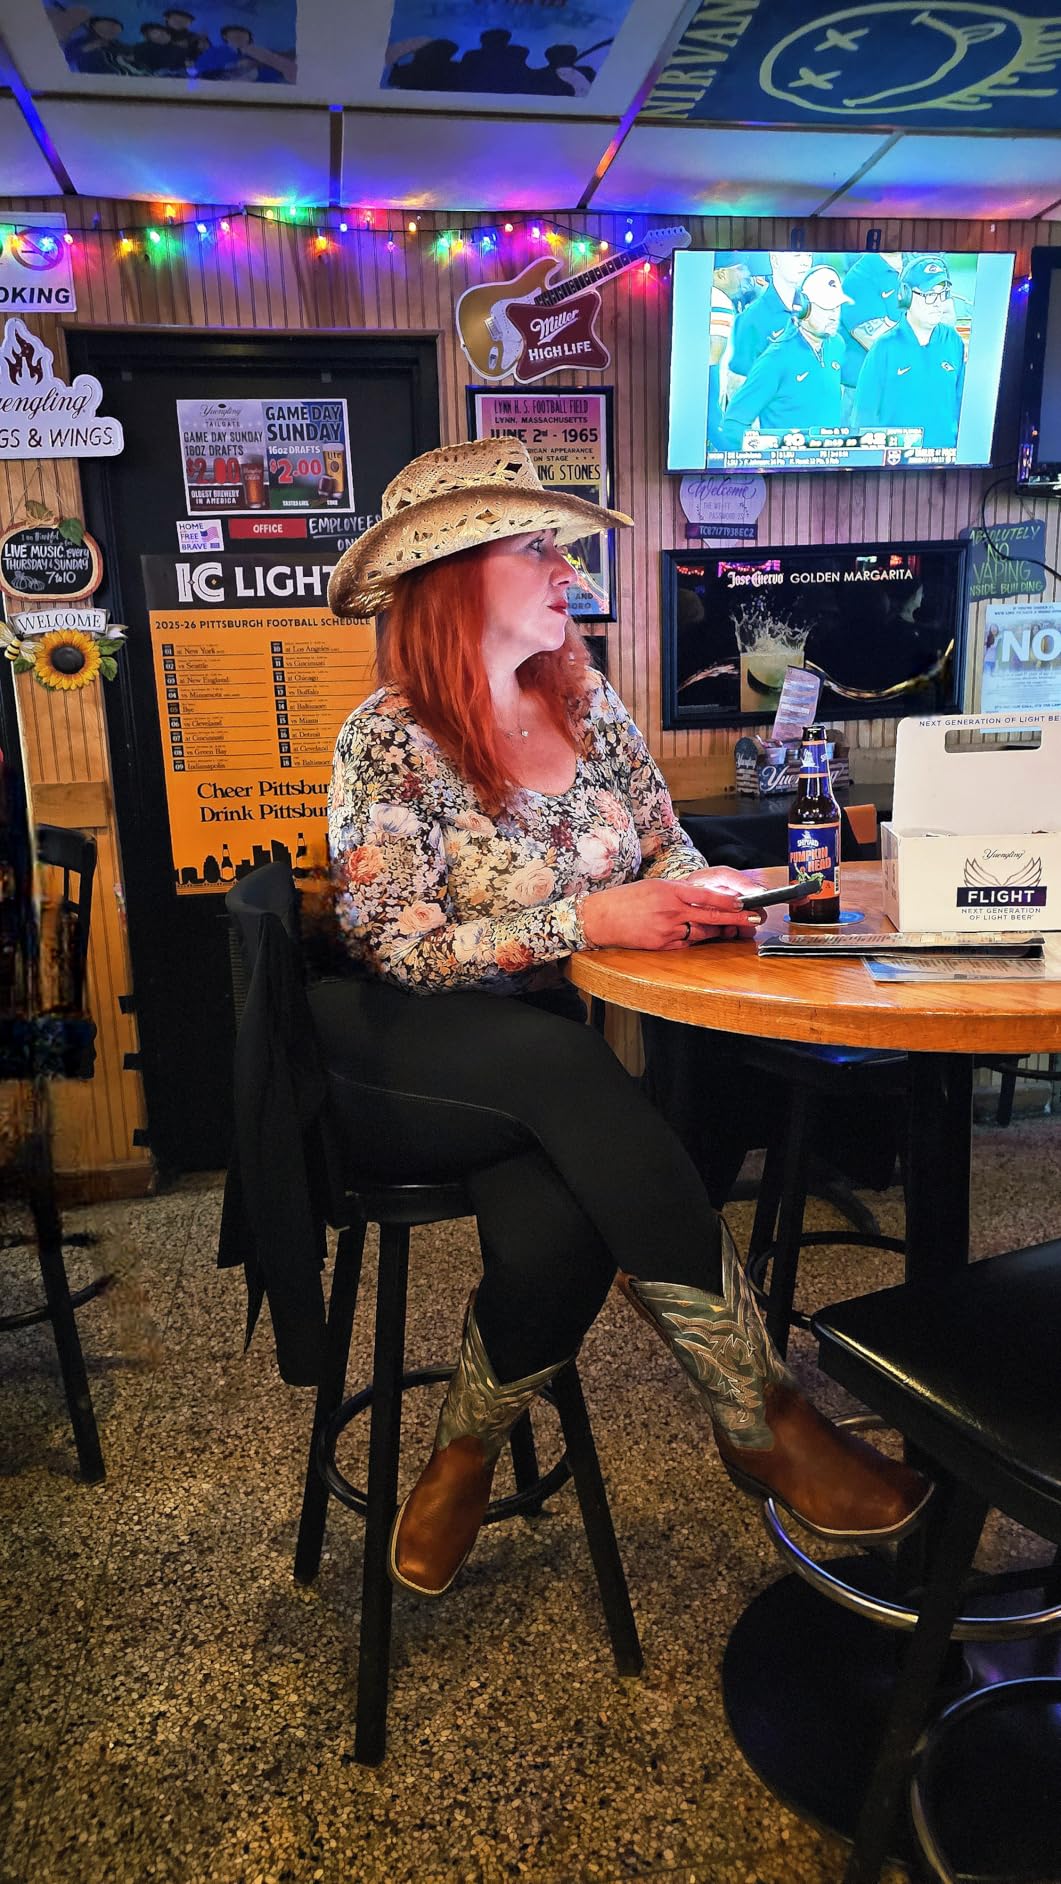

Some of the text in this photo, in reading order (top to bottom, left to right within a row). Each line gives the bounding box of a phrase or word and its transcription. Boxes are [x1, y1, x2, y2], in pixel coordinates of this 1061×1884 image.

[530, 309, 579, 342] Miller
[528, 341, 592, 361] HIGH LIFE
[0, 385, 93, 420] engling
[495, 400, 511, 414] LYNN
[533, 400, 567, 414] FOOTBALL
[570, 400, 588, 414] FIELD
[265, 406, 341, 421] GAME DAY
[521, 416, 588, 424] MASSACHUSETTS
[28, 428, 42, 448] &
[50, 427, 113, 447] WINGS
[184, 431, 263, 443] GAME DAY SUNDAY
[267, 422, 342, 442] SUNDAY
[561, 428, 598, 443] 1965
[209, 445, 244, 457] DRAFTS
[289, 446, 321, 454] DRAFTS
[269, 458, 323, 484] $2.00
[560, 464, 600, 481] STONES
[688, 477, 756, 500] Welcome
[252, 524, 283, 533] OFFICE
[4, 544, 89, 560] LIVE MUSIC every
[337, 538, 358, 551] ON
[987, 542, 1010, 562] NO
[2, 557, 48, 570] THURSDAY
[54, 558, 89, 571] SUNDAY
[790, 572, 840, 584] GOLDEN
[844, 569, 913, 582] MARGARITA
[973, 560, 1031, 584] VAPING
[18, 613, 101, 632] WELCOME
[155, 617, 371, 629] 2025-26 PITTSBURGH FOOTBALL SCHEDULE
[200, 647, 215, 655] York
[1001, 628, 1061, 662] NO
[945, 718, 1000, 726] GENERATION
[1019, 715, 1045, 723] LIGHT
[215, 748, 227, 756] Bay
[197, 782, 253, 799] Cheer
[200, 805, 255, 822] Drink
[790, 846, 828, 863] PUMPKIN
[982, 848, 1026, 861] Yuengling
[807, 857, 832, 873] HEAD
[967, 889, 1035, 904] FLIGHT
